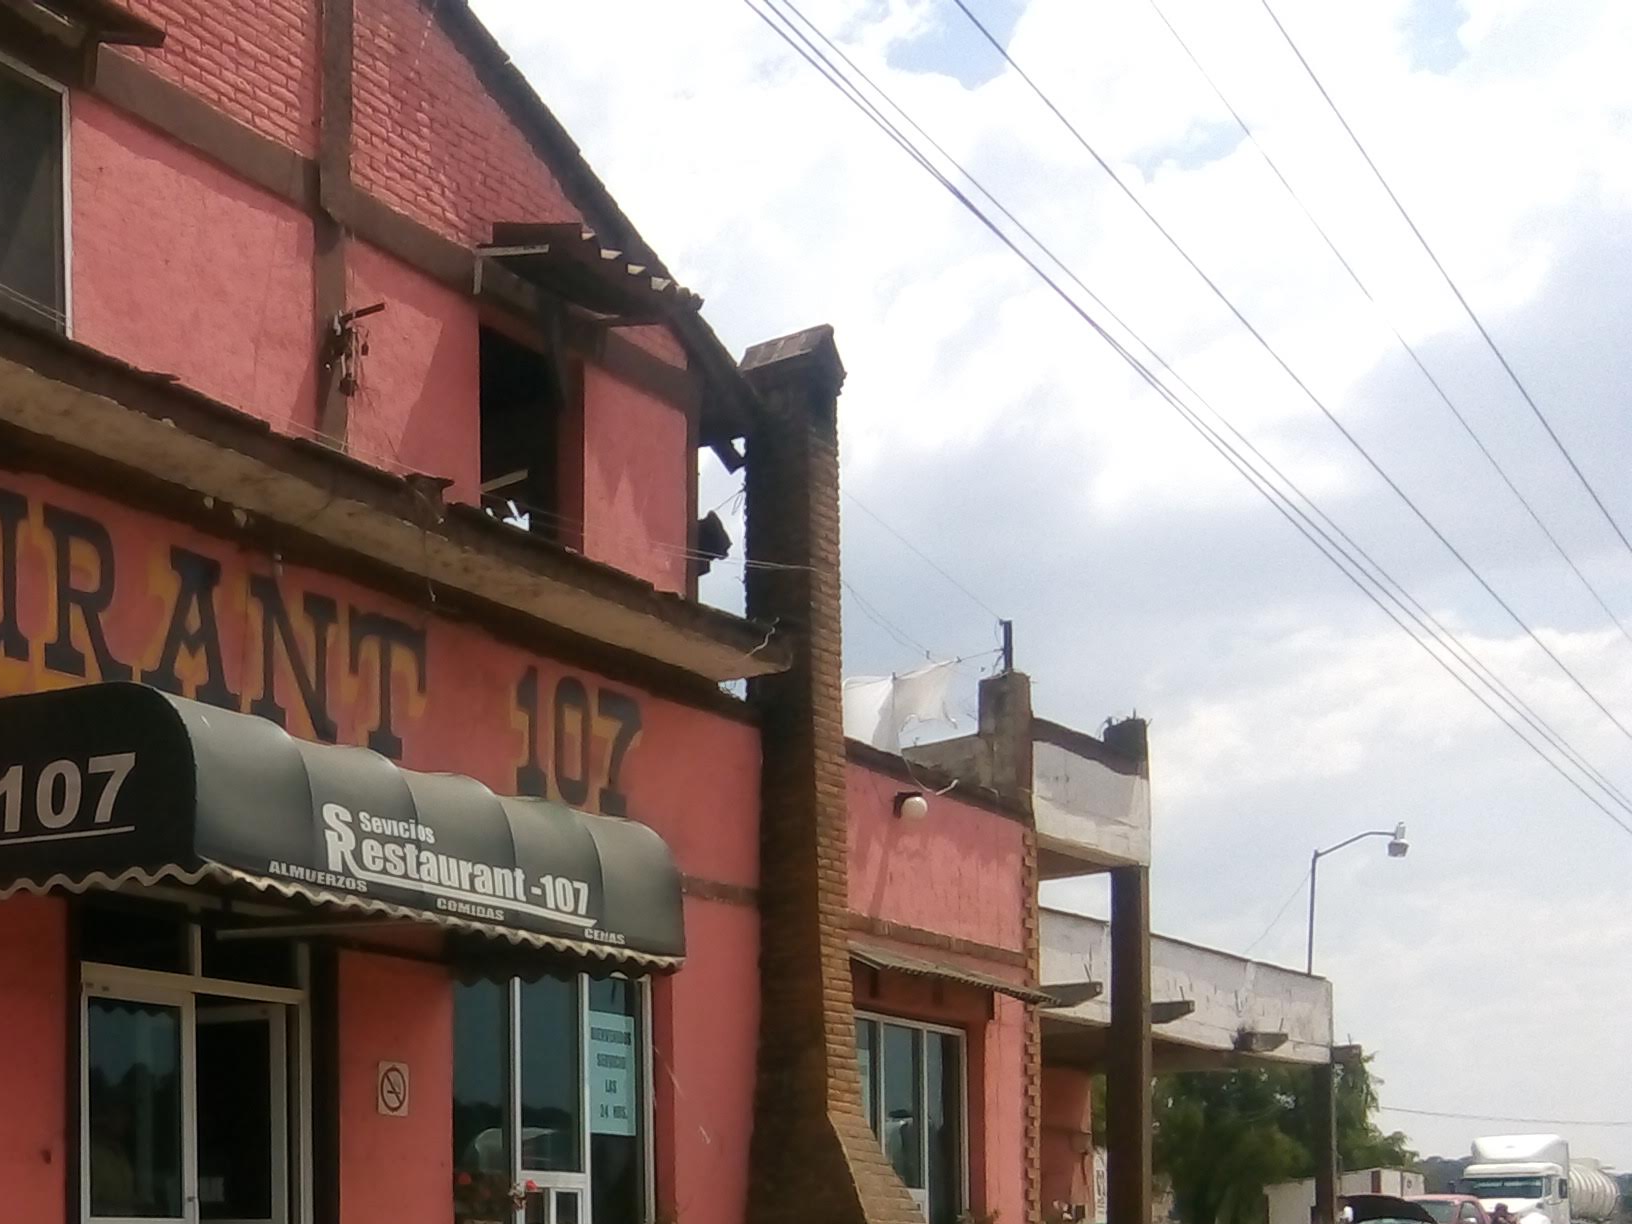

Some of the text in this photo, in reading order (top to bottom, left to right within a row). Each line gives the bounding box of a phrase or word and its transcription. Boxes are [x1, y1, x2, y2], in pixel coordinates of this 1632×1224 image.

[515, 665, 642, 818] 107
[359, 811, 436, 844] Sevicios
[268, 861, 368, 893] ALMUERZOS
[324, 829, 526, 902] Restaurant
[436, 898, 505, 921] COMIDAS
[584, 927, 626, 945] CENAS
